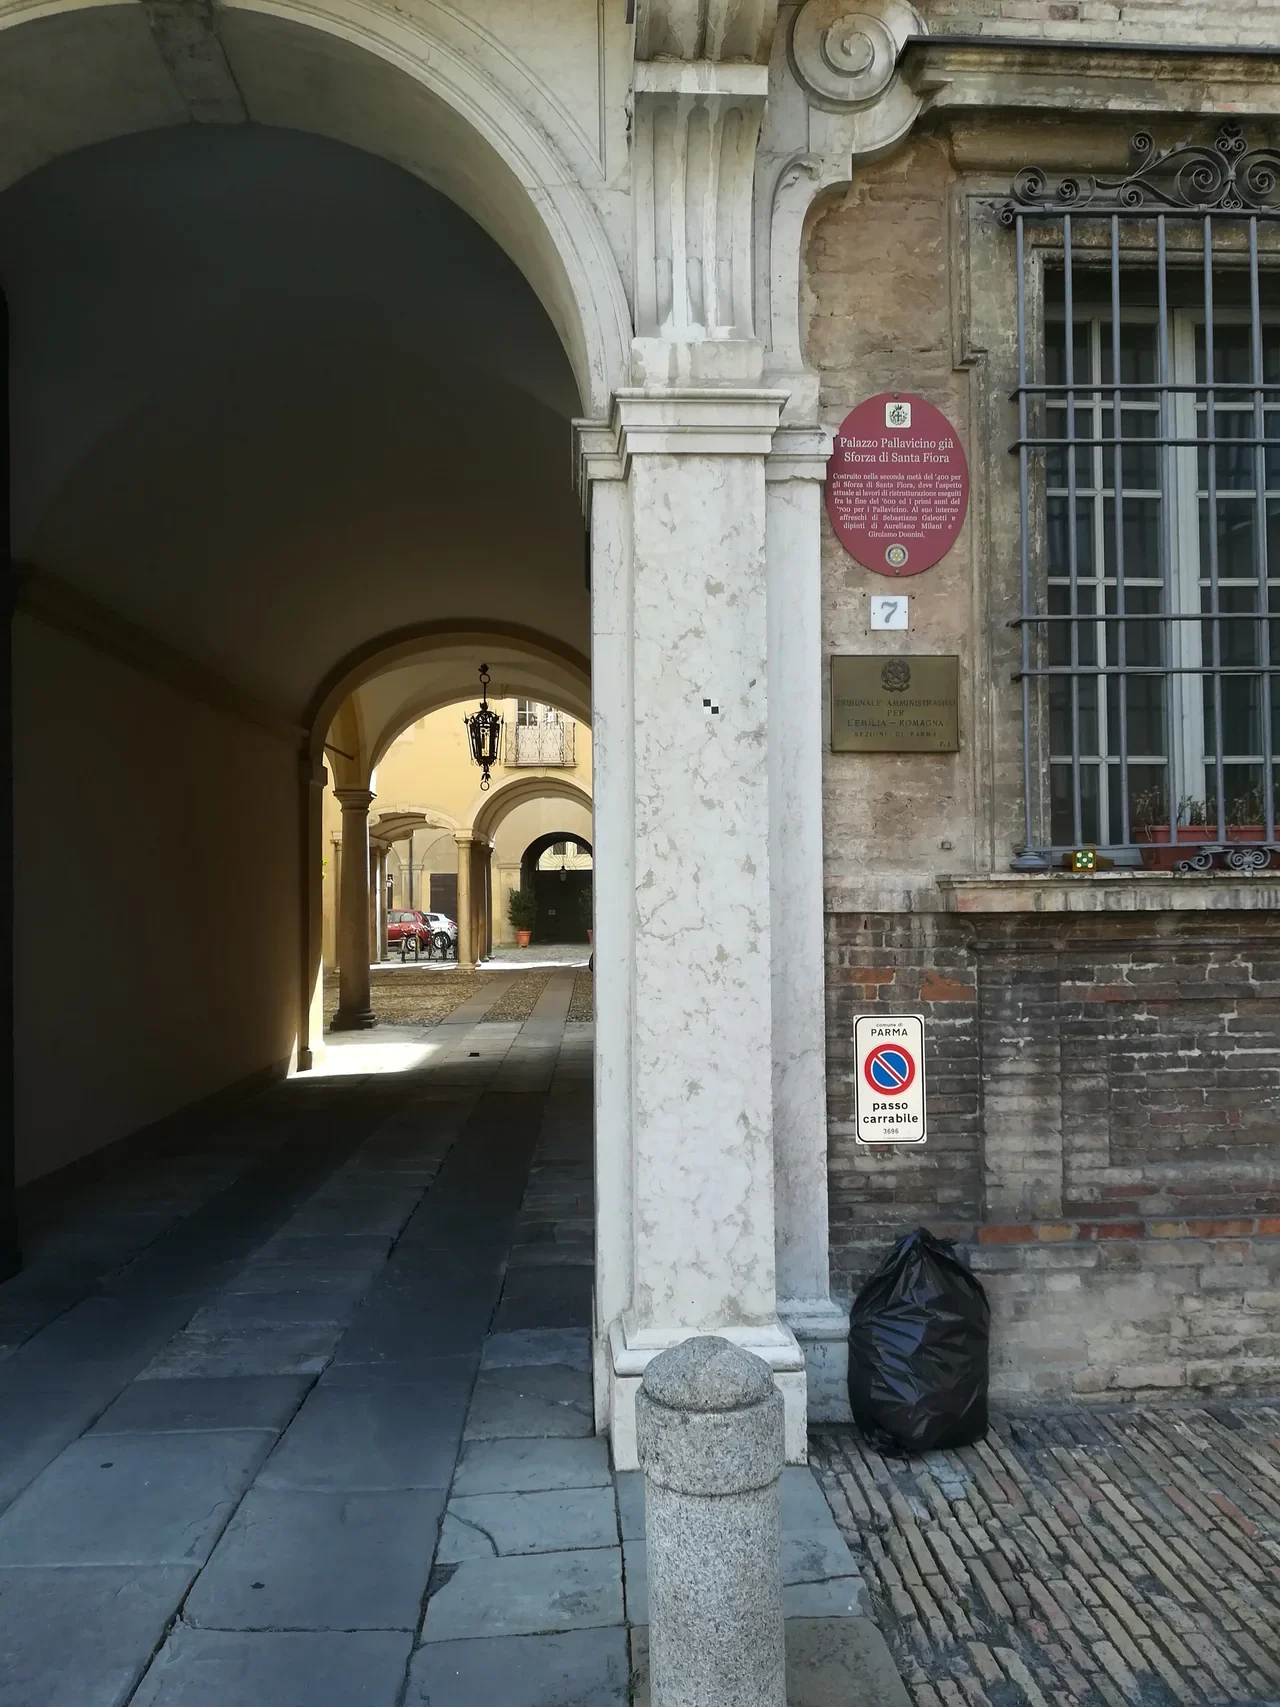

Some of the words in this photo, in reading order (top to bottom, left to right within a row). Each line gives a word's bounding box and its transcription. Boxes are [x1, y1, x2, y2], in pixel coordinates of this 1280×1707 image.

[840, 438, 878, 448] Palazzo
[881, 438, 936, 448] Pallavicino
[938, 439, 953, 450] già
[844, 452, 876, 462] Sforza
[879, 452, 888, 462] di
[892, 453, 920, 463] Santa
[923, 453, 949, 463] Fiora
[881, 601, 898, 623] 7
[871, 1028, 908, 1036] PARMA
[872, 1102, 908, 1111] passo
[863, 1114, 918, 1123] carrabile
